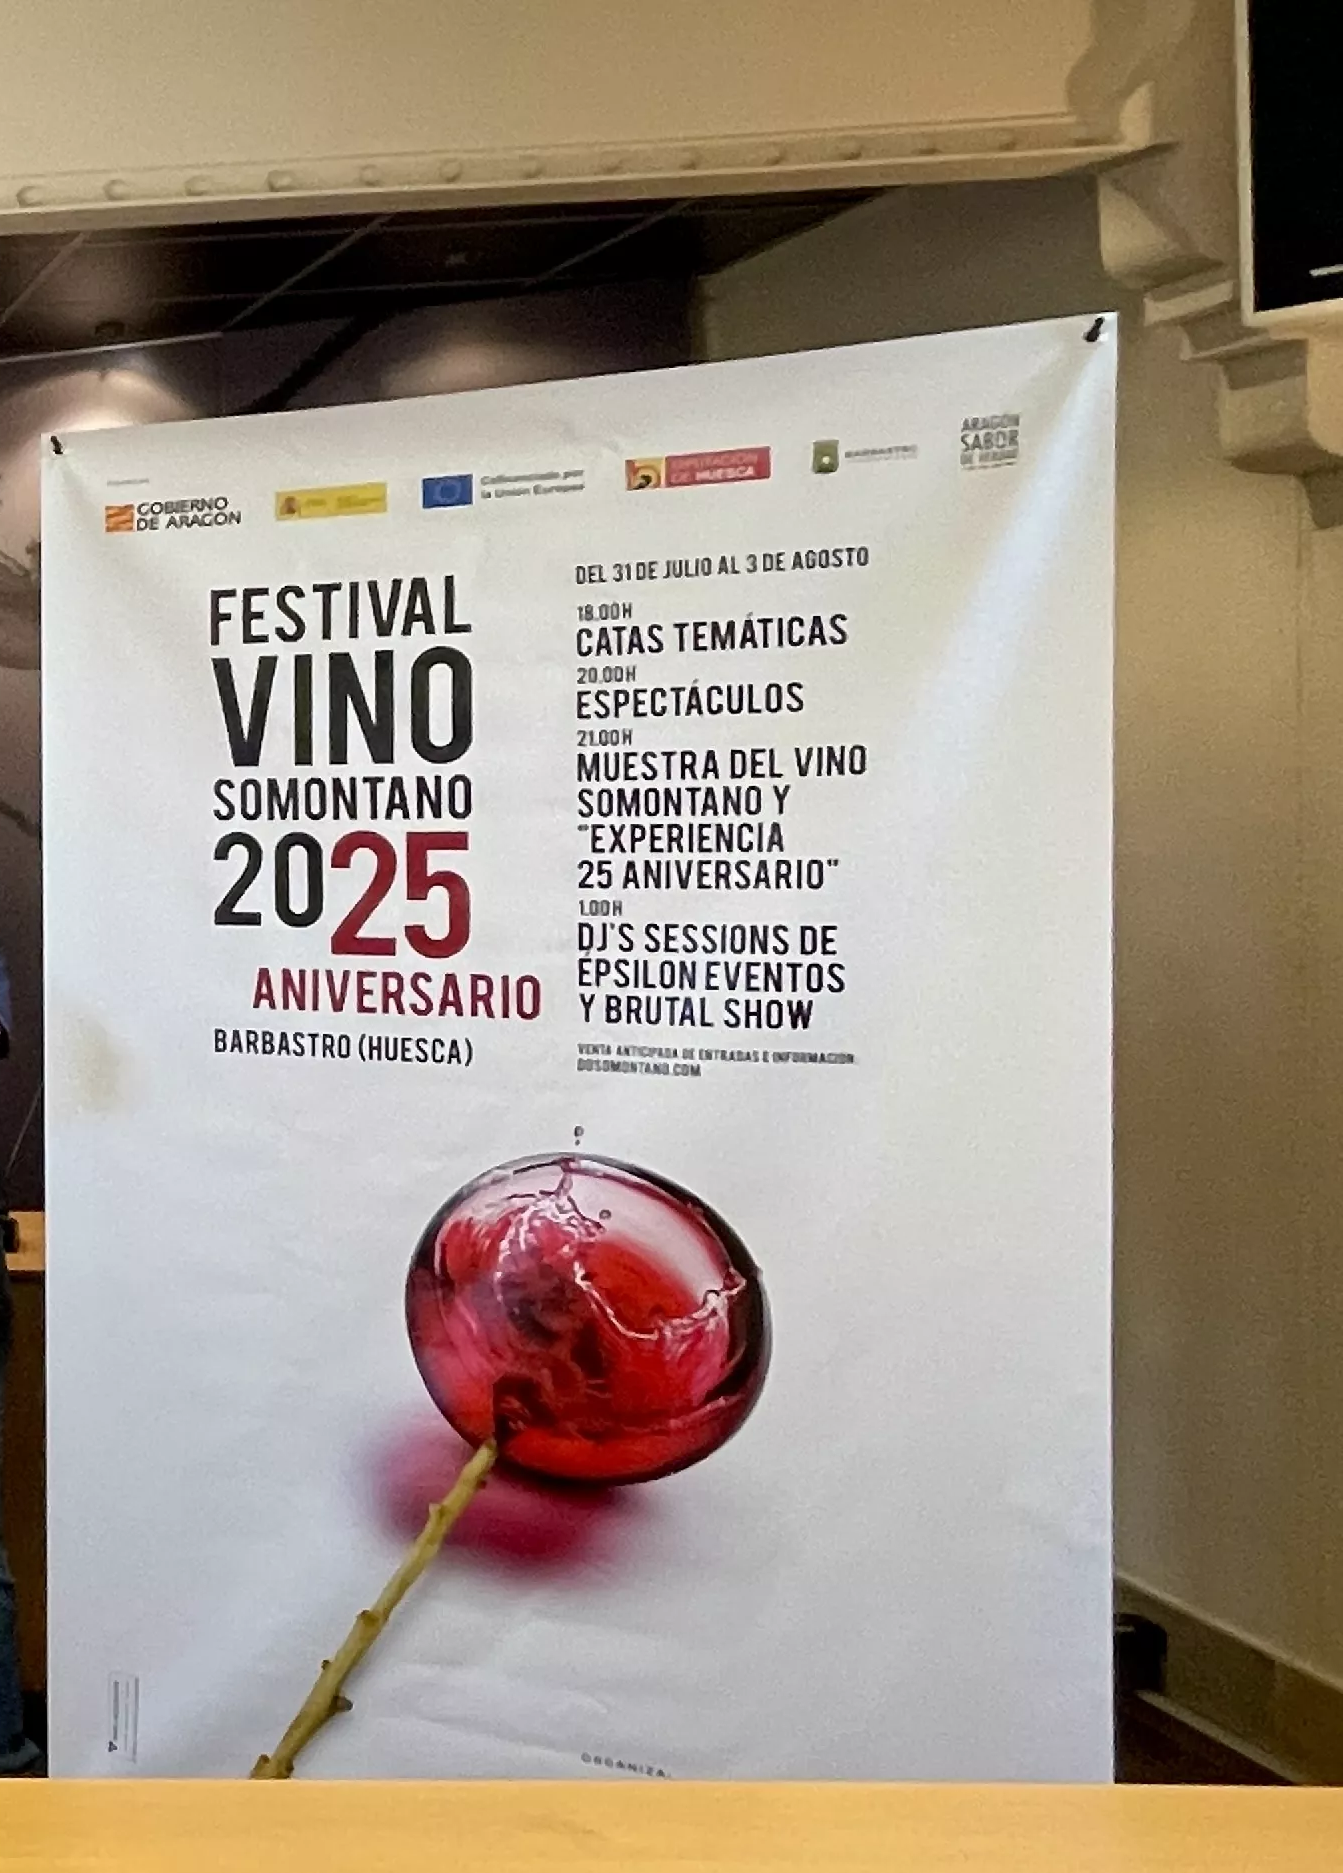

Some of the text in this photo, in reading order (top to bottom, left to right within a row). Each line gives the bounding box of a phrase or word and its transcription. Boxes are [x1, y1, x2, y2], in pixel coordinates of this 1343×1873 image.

[136, 496, 228, 516] GOBIERNO
[136, 517, 159, 531] DE
[575, 546, 869, 584] DEL 31 DE JULIO AL 3 DE AGOSTO
[210, 575, 472, 646] FESTIVAL
[577, 602, 632, 621] 18.00H
[577, 612, 848, 657] CATAS TEMÁTICAS
[577, 665, 637, 684] 20.00H
[211, 646, 473, 767] VINO
[577, 679, 804, 719] ESPECTÁCULOS
[577, 744, 867, 782] MUESTRA DEL VINO
[213, 774, 472, 821] SOMONTANO
[577, 784, 790, 817] SOMONTANO Y
[578, 859, 839, 890] 25 ANIVERSARIO"
[213, 830, 471, 959] 2025
[578, 922, 837, 955] DJ'S SESSIONS DE
[578, 952, 845, 993] ÉPSILON EVENTOS
[252, 967, 541, 1020] ANIVERSARIO
[579, 993, 814, 1030] Y BRUTAL SHOW
[214, 1028, 474, 1067] BARBASTRO (HUESCA)
